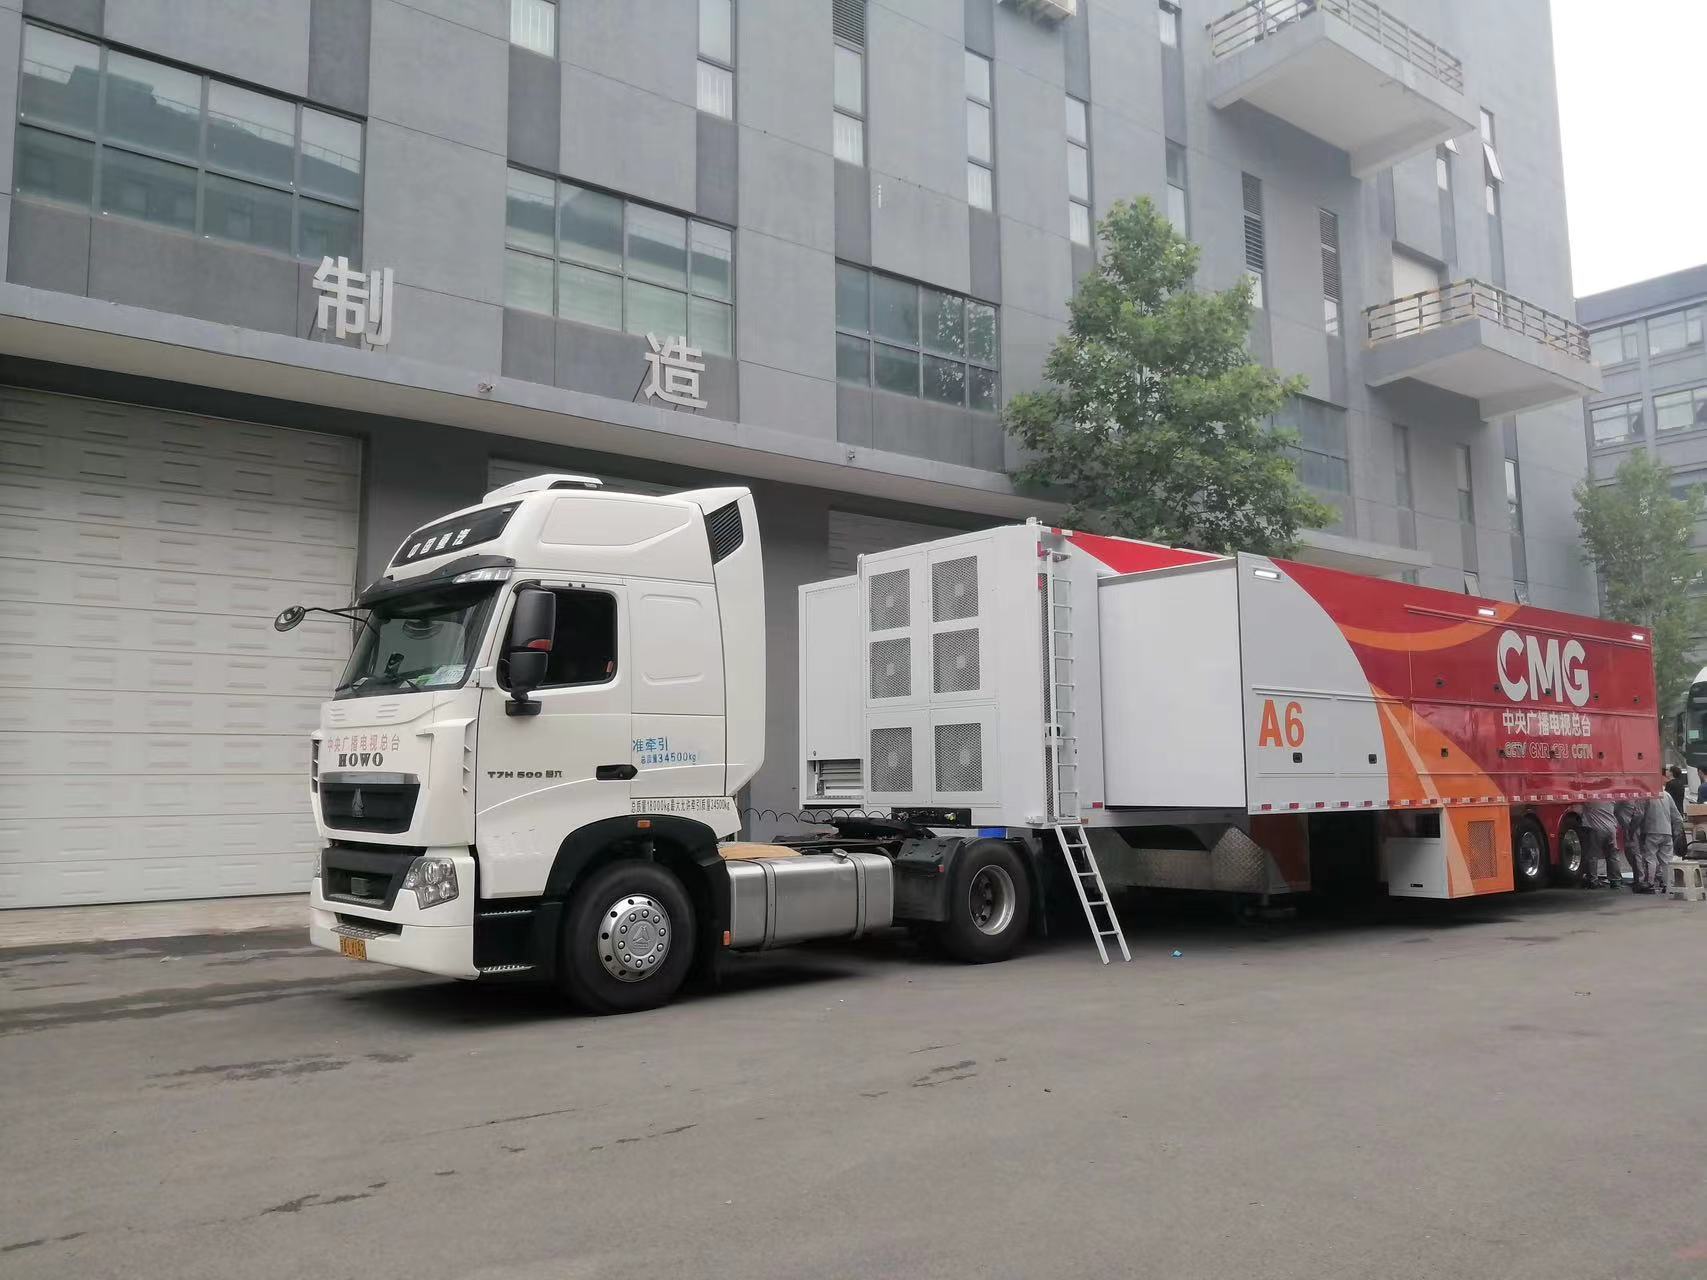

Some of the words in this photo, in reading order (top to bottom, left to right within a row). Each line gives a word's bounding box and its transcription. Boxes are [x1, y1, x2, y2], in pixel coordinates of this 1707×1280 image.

[312, 255, 394, 345] 制
[643, 332, 708, 408] 造
[1497, 629, 1590, 707] CMG
[1258, 699, 1305, 748] A6
[1502, 709, 1591, 737] 中央广播电视总台
[327, 733, 401, 752] 中央广播电视总台
[632, 736, 669, 752] 准牵引
[338, 752, 384, 767] HOWO
[487, 771, 514, 779] T7H
[516, 771, 543, 779] 500
